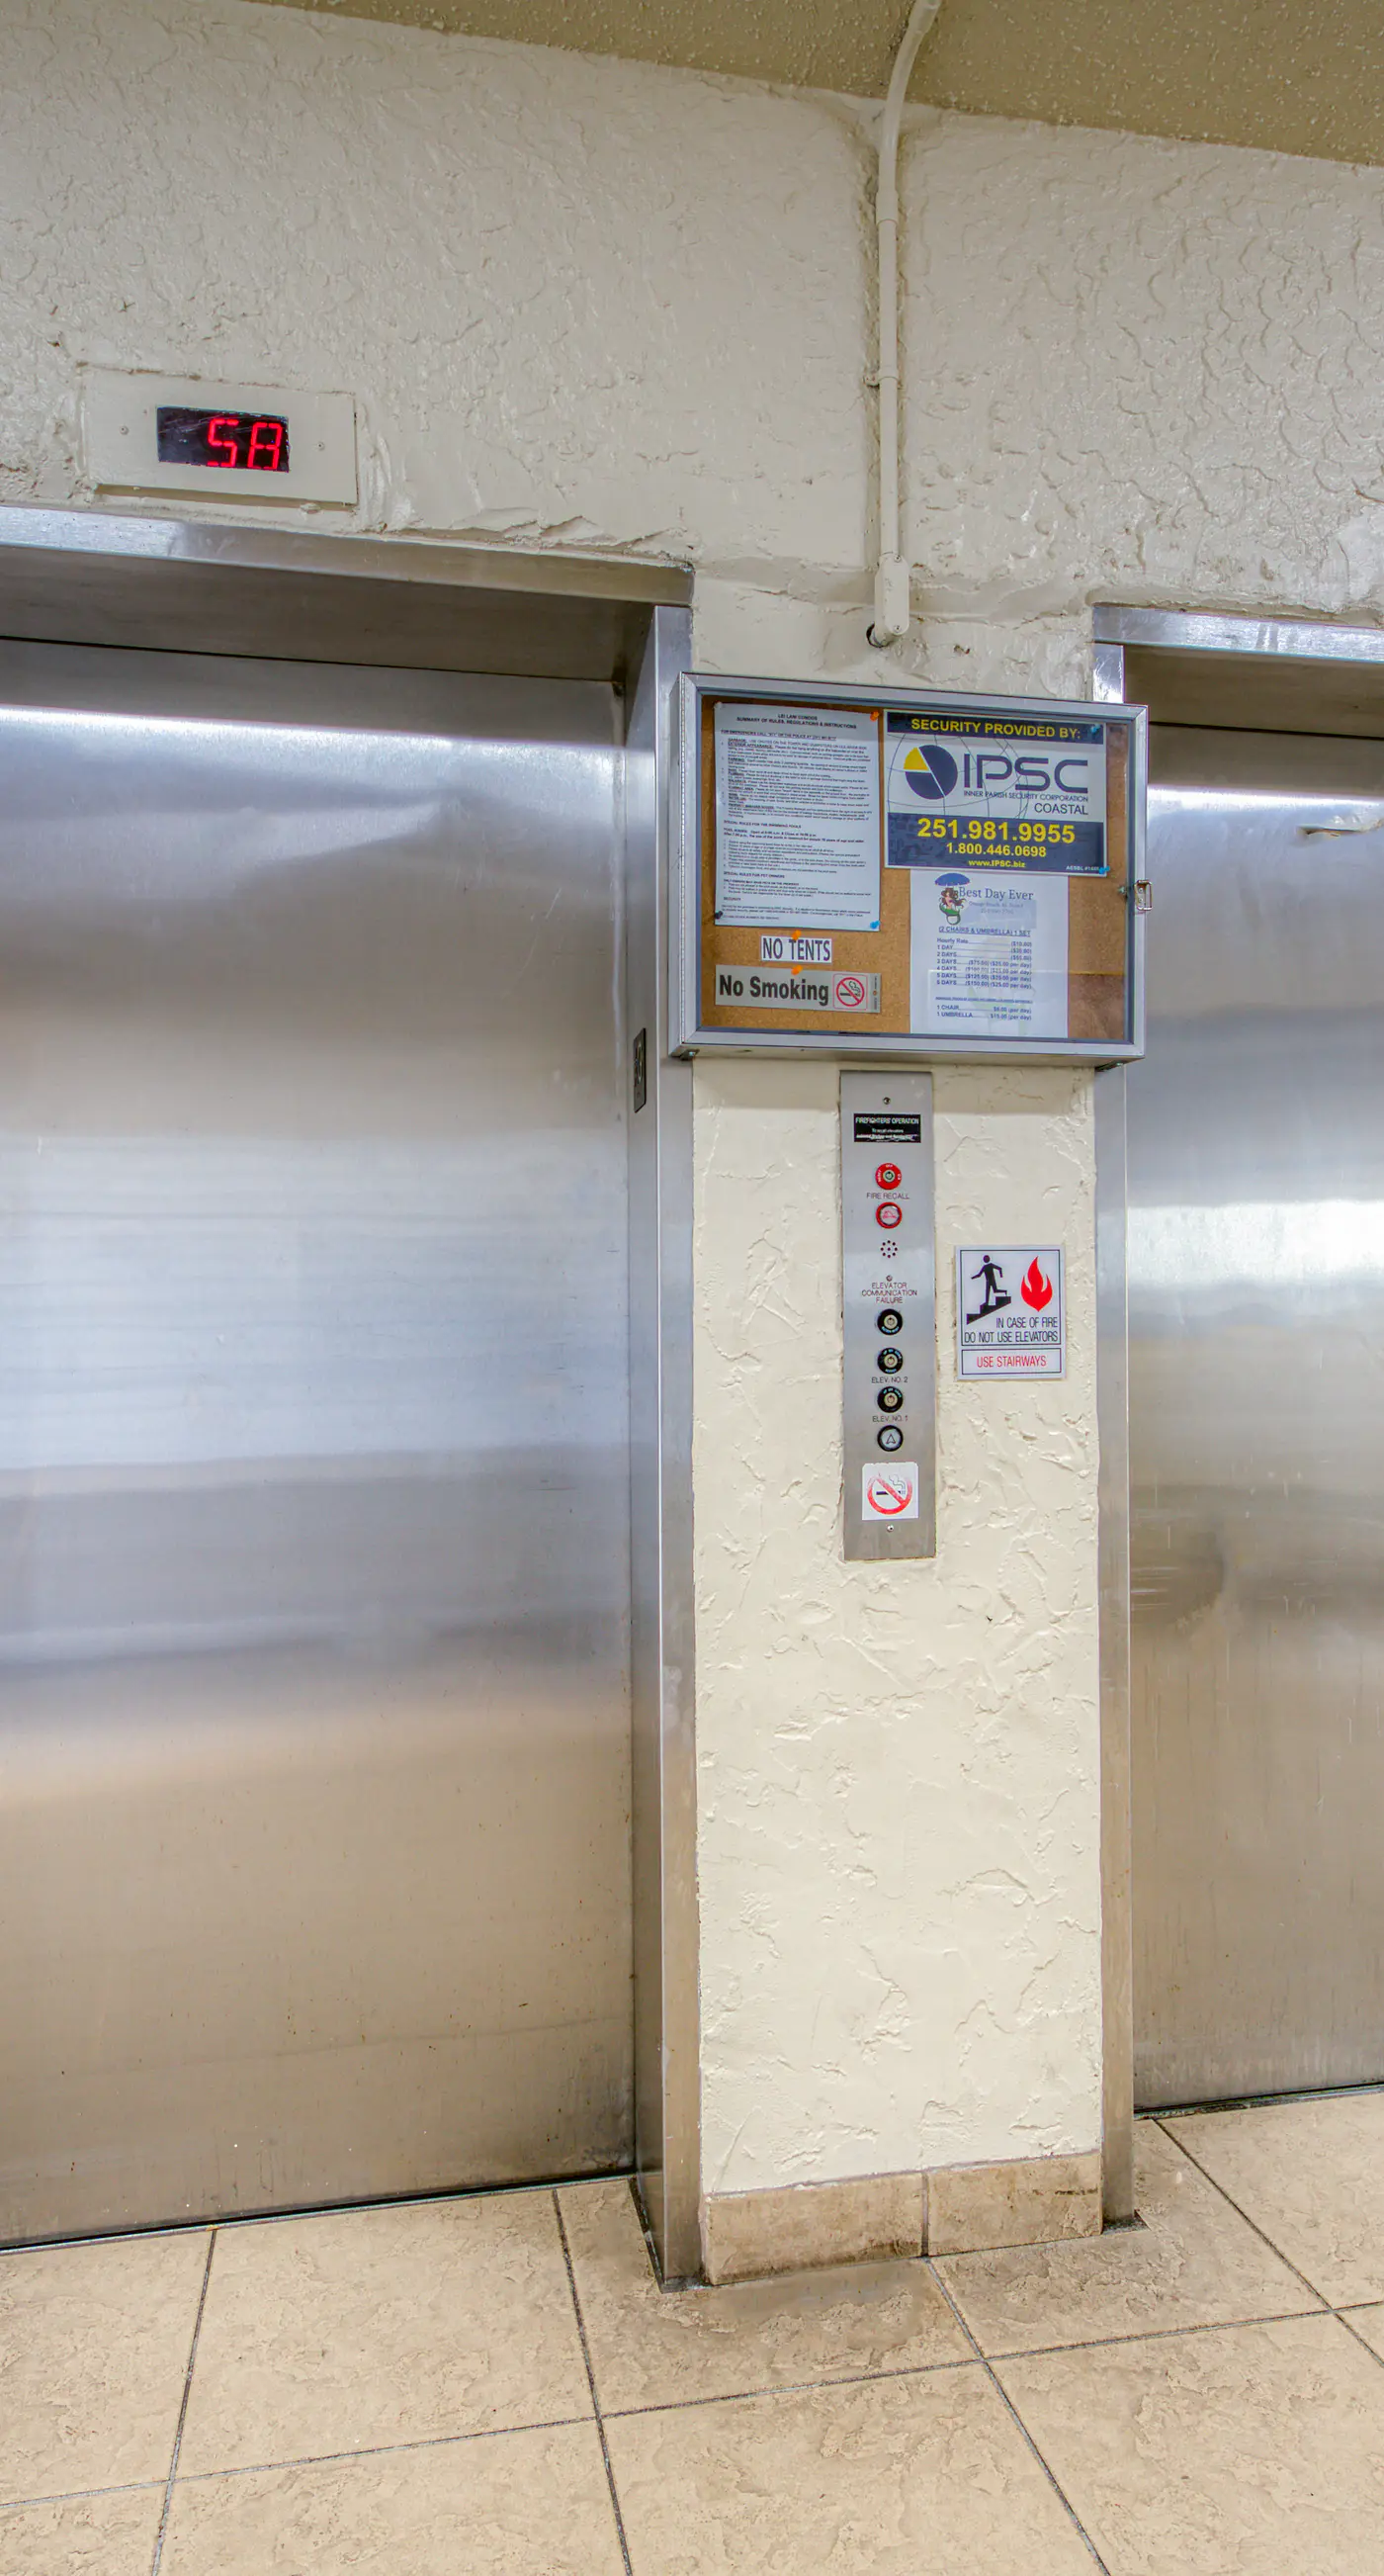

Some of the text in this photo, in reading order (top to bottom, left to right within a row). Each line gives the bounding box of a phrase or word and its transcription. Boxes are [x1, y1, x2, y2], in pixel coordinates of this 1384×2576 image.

[910, 718, 1081, 739] SECURITY PROVIDED BY:
[964, 754, 1088, 794] IPSC
[1039, 793, 1088, 802] CORPORATION
[1034, 803, 1088, 815] COASTAL
[917, 818, 1076, 844] 251.981.9955
[946, 843, 1047, 857] 1.800.446.0698
[968, 859, 1027, 868] www.IPSC.biz
[958, 886, 1034, 902] Best Day Ever
[762, 937, 830, 961] NO TENTS
[719, 974, 829, 1007] No Smoking
[996, 1316, 1058, 1328] IN CASE OF FIRE
[964, 1330, 1058, 1343] DO NOT USE ELEVATORS
[977, 1355, 1047, 1368] USE STAIRWAYS
